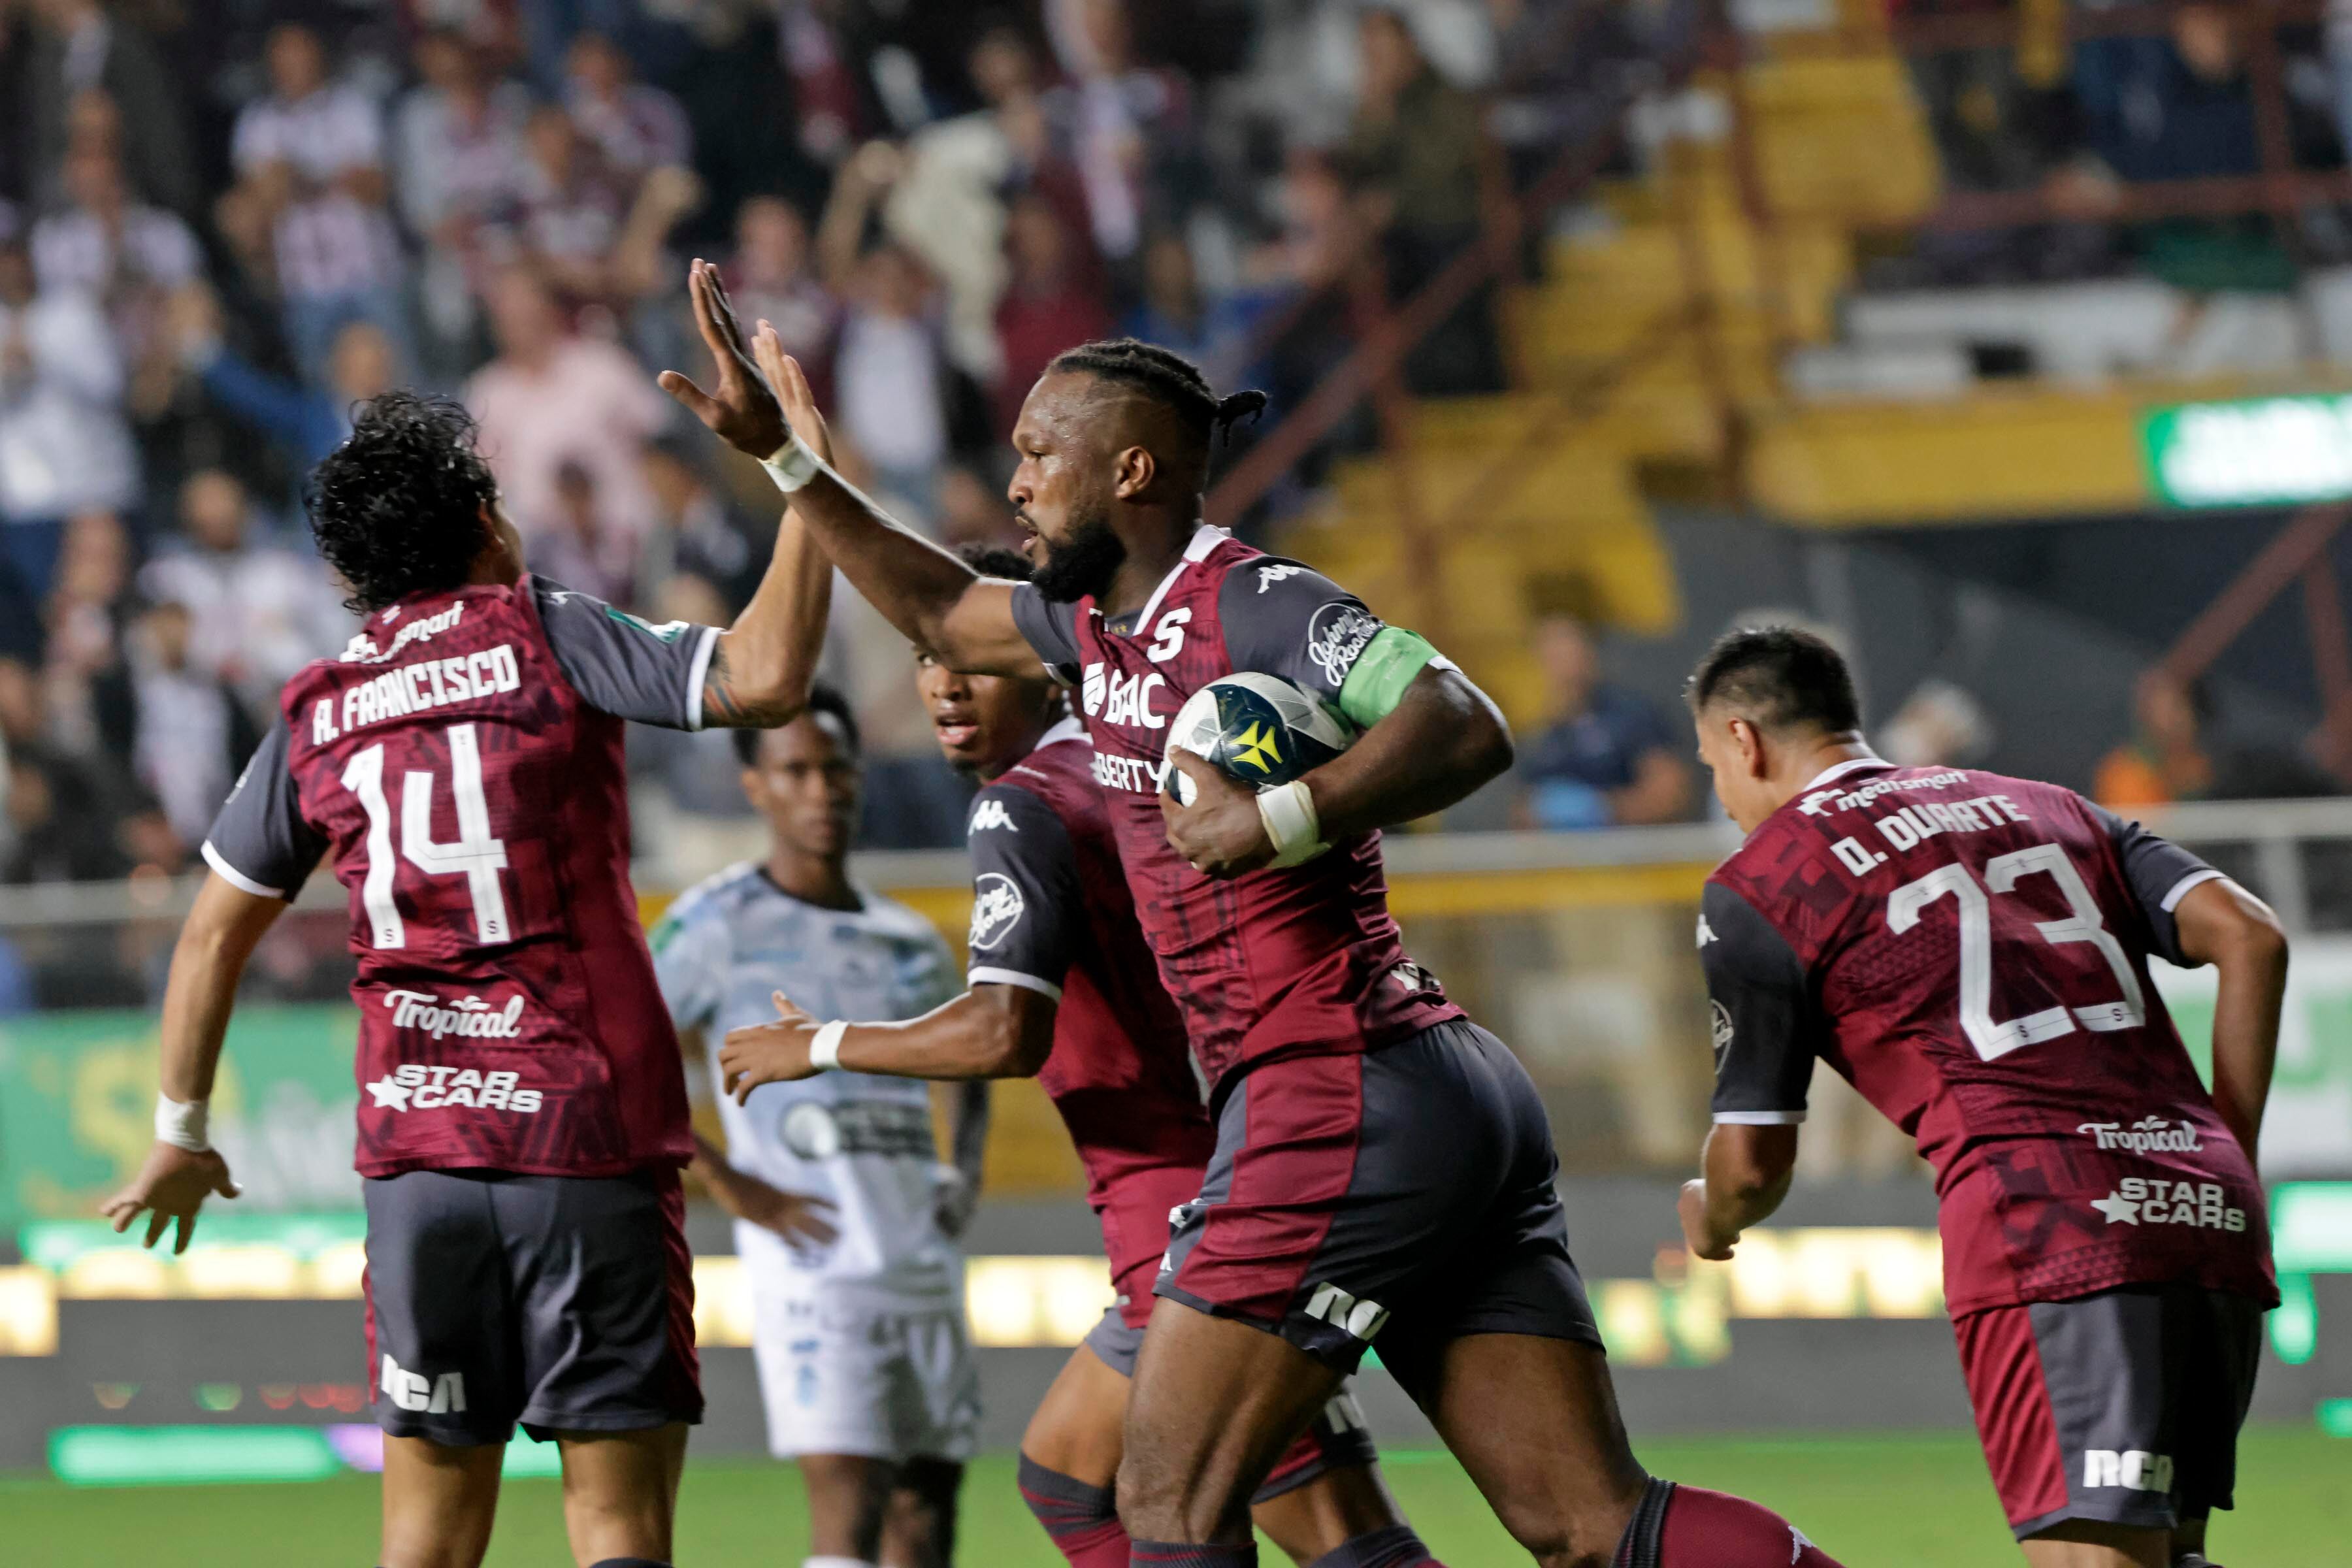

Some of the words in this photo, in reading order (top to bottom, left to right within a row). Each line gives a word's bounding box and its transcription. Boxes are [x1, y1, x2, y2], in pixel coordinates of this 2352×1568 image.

[1146, 607, 1192, 663] S
[312, 698, 340, 745] A.
[342, 644, 521, 732] FRANCISCO
[1092, 750, 1167, 794] BERTY
[340, 723, 511, 949] 14
[1874, 794, 2031, 852] DUARTE
[1886, 842, 2146, 1062] 23
[384, 989, 525, 1040] Tropical
[395, 1064, 520, 1091] STAR
[411, 1085, 544, 1113] CARS
[2076, 1115, 2204, 1156] Tropical
[2120, 1177, 2224, 1207] STAR
[2142, 1200, 2246, 1232] CARS
